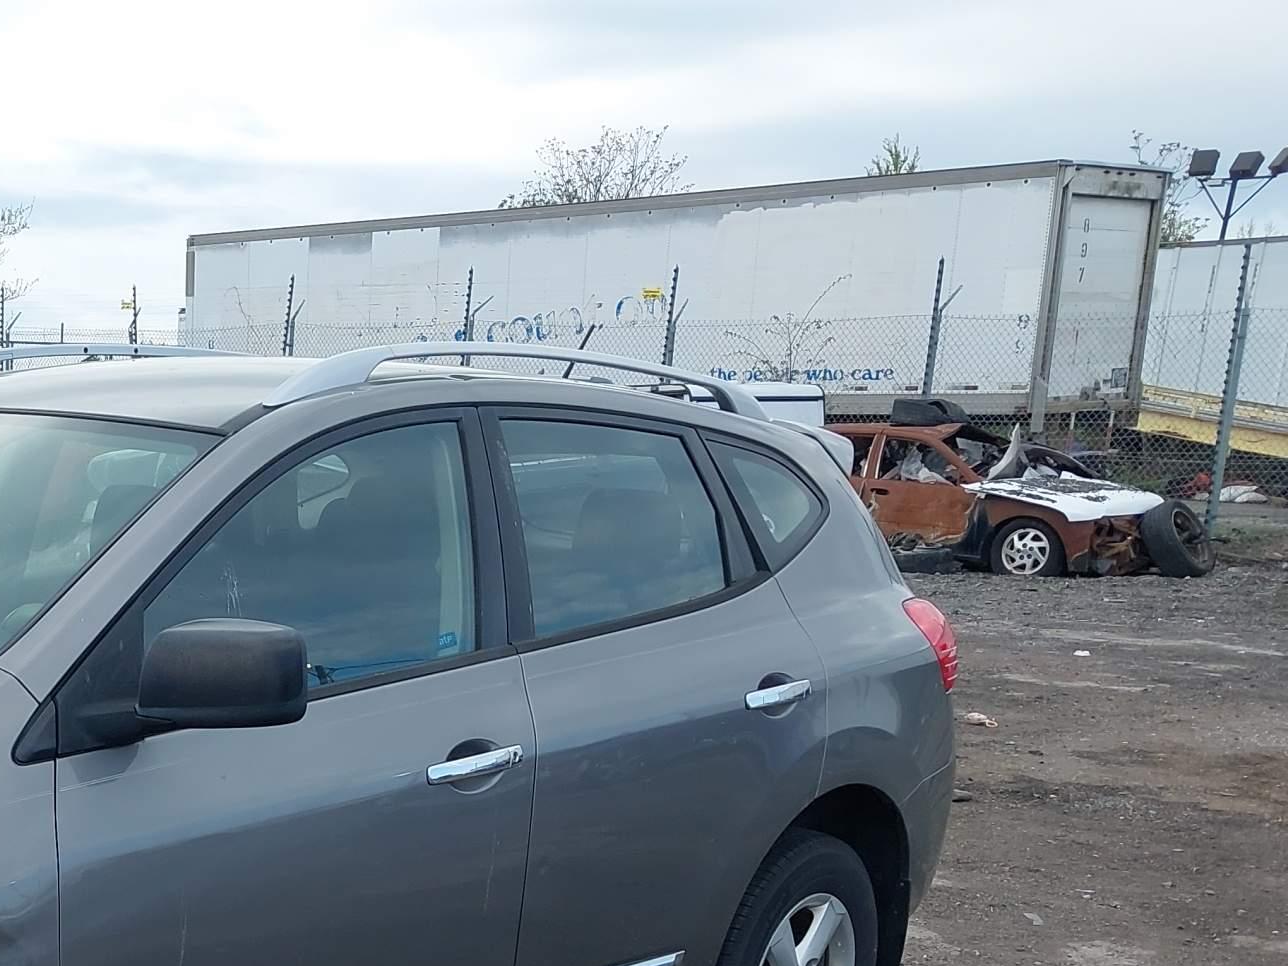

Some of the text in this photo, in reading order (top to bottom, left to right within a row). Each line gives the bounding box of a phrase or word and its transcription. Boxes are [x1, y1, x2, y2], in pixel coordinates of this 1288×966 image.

[710, 367, 737, 382] the
[806, 367, 845, 382] who
[853, 367, 898, 382] care
